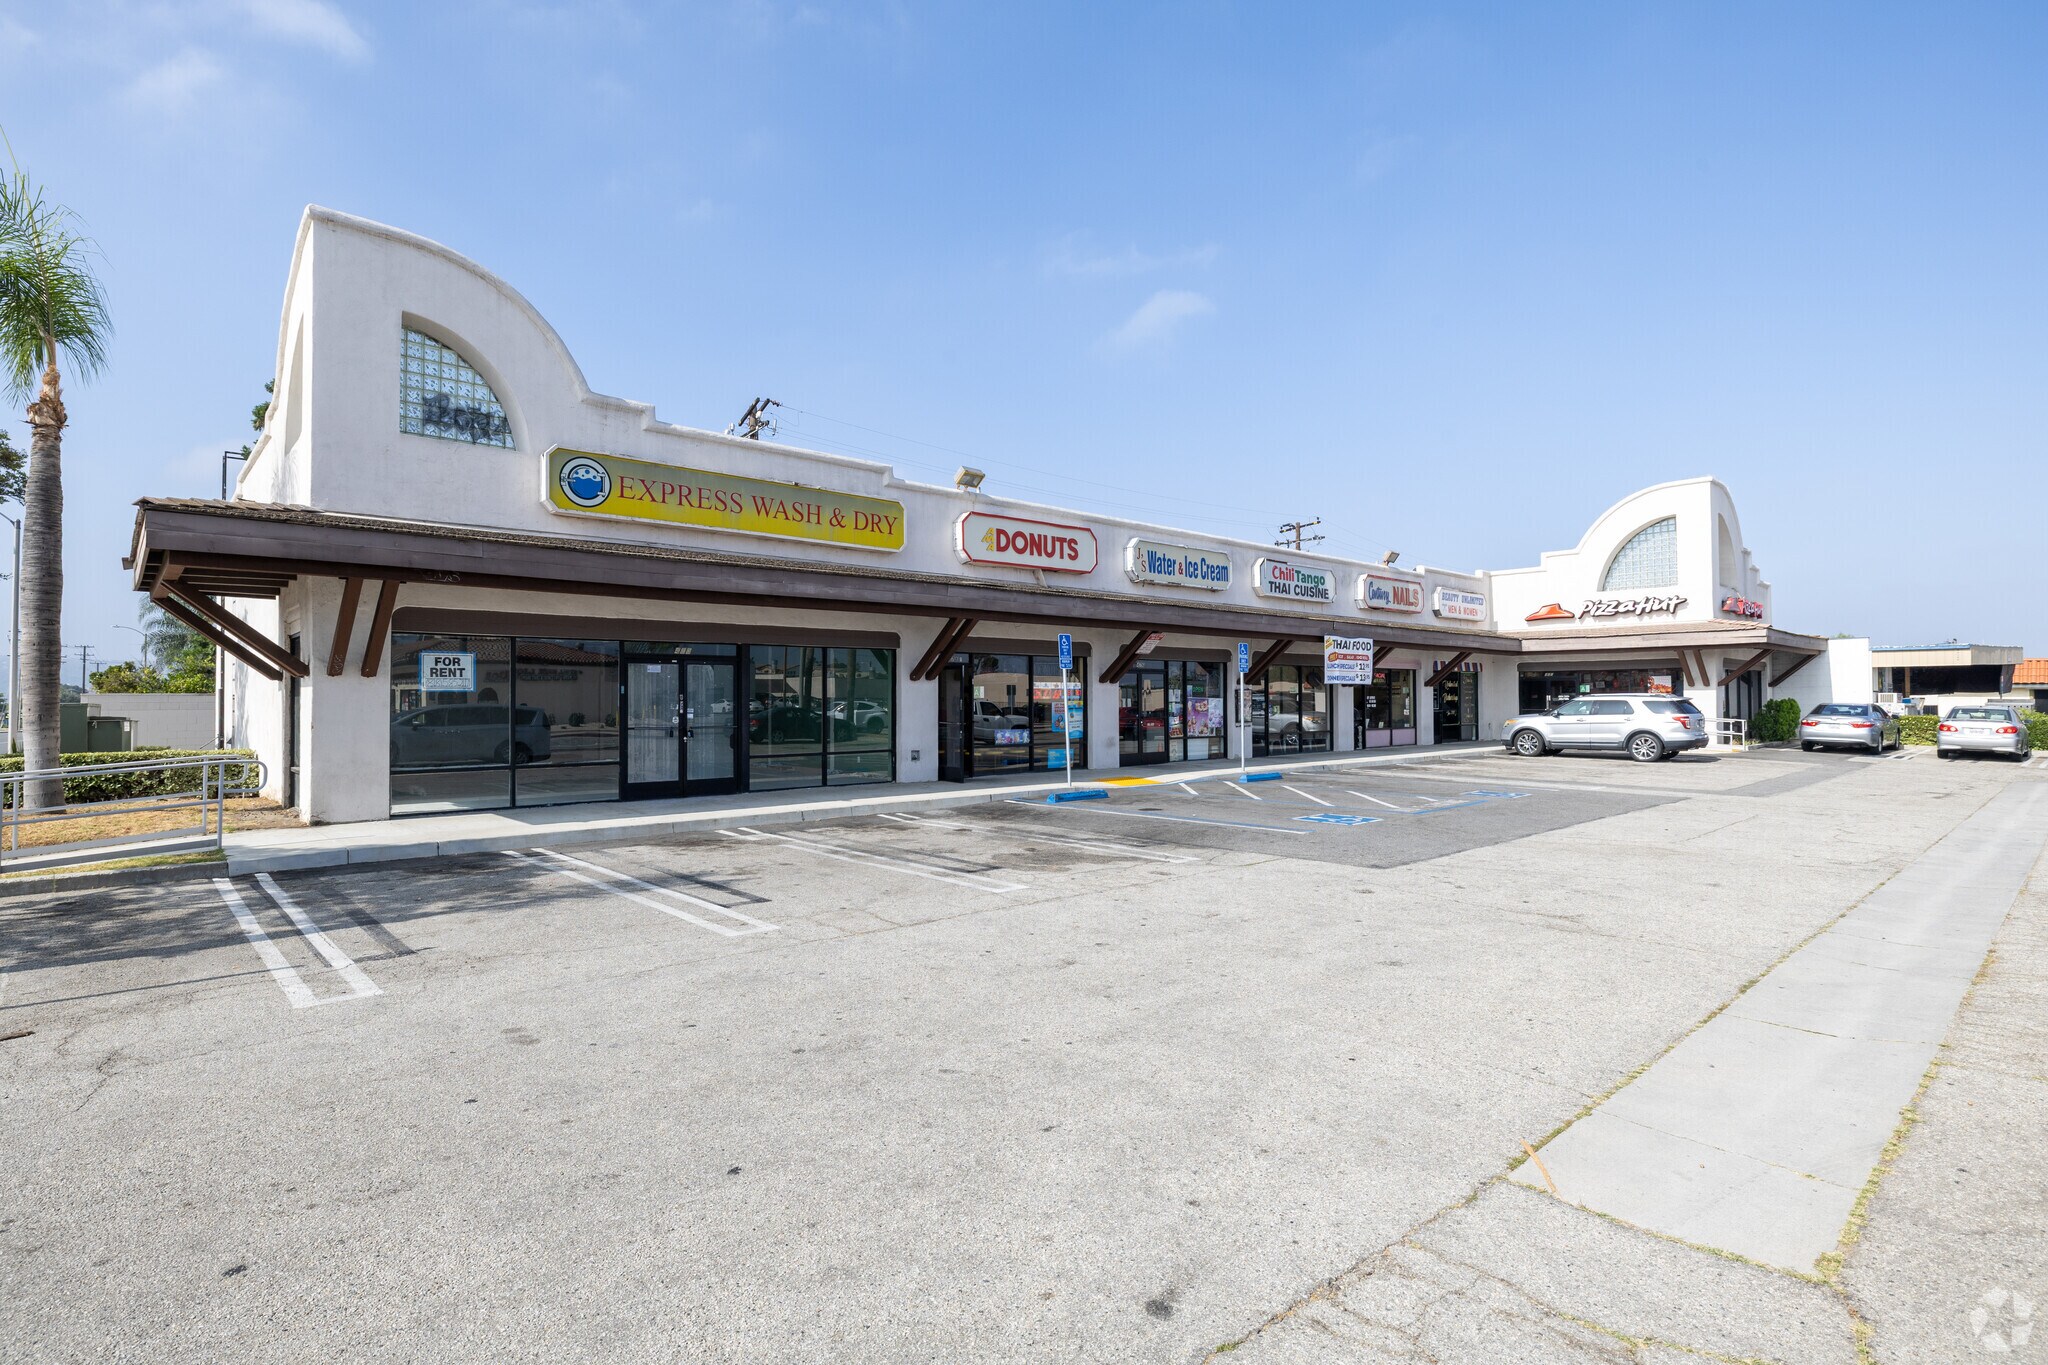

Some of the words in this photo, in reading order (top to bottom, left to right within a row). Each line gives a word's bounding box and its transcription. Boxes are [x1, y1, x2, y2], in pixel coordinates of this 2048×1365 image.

[617, 475, 743, 514] EXPRESS
[751, 495, 822, 525] WASH
[829, 507, 846, 529] &
[853, 510, 898, 535] DRY
[995, 528, 1079, 561] DONUTS
[1147, 550, 1176, 576] Water
[1178, 561, 1184, 575] &
[1184, 555, 1198, 579] Ice
[1200, 557, 1229, 582] Cream
[1268, 580, 1291, 595] THAI
[1294, 584, 1330, 600] CUISINE
[1392, 586, 1419, 608] NAILS
[1441, 591, 1459, 603] BEAUTY
[1461, 594, 1484, 606] UNLIMITED
[1447, 604, 1457, 614] MEN
[1463, 606, 1478, 617] WOMEN
[1332, 640, 1351, 650] THAI
[1351, 641, 1372, 651] FOOD
[434, 656, 461, 667] FOR
[429, 667, 466, 678] RENT
